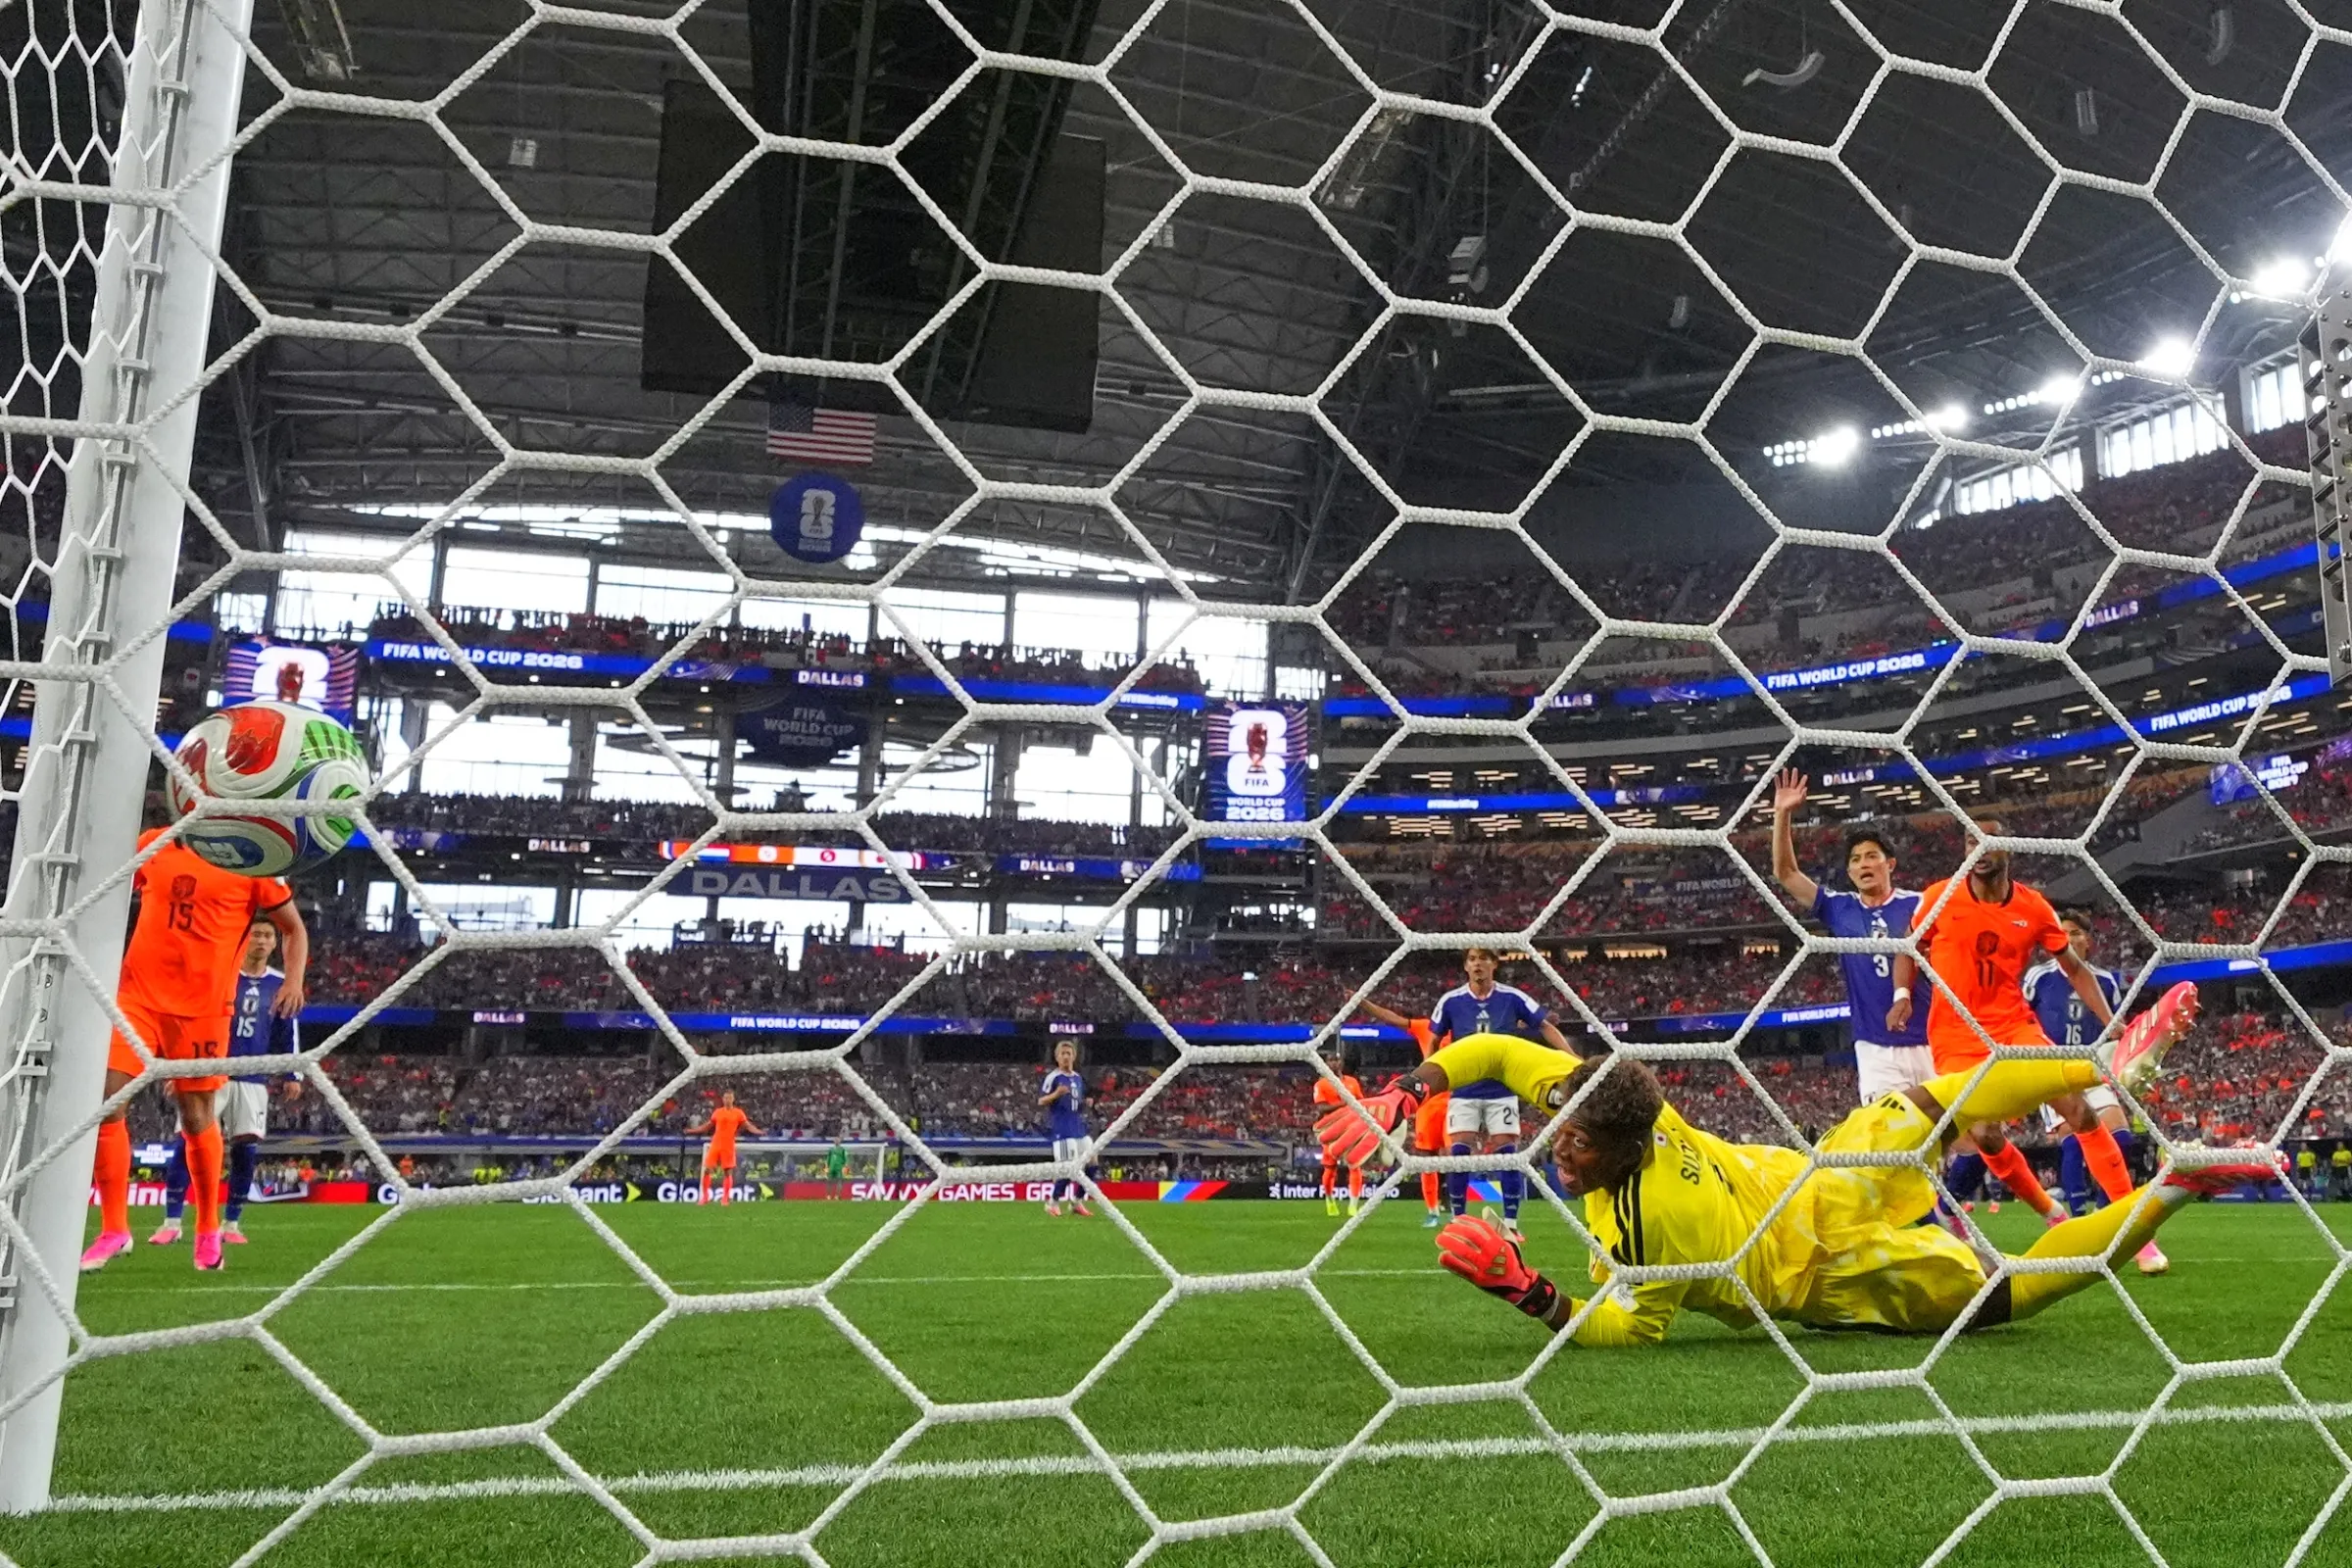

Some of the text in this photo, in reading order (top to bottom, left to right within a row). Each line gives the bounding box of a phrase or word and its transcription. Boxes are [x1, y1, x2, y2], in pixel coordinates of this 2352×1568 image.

[2085, 601, 2138, 627] DALLAS
[382, 643, 583, 669] FIFA WOLD CUP 2026
[798, 670, 864, 686] DALLAS
[1767, 654, 1926, 689] FIFA WORLD CUP 2026
[1534, 694, 1592, 708] DLLAS
[793, 707, 825, 722] FIFA
[2151, 713, 2178, 731] FIFA
[2177, 703, 2222, 726] WORLD
[2222, 697, 2246, 713] CUP
[763, 717, 855, 736] WORLD CUP
[1245, 778, 1269, 787] FIFA
[1823, 769, 1874, 787] DALLAS
[1227, 797, 1286, 808] WORLD CUP
[1226, 807, 1285, 821] 2026
[527, 839, 590, 853] DALLAS
[1020, 859, 1075, 873] DALLAS
[692, 870, 902, 902] DALLAS
[1676, 877, 1741, 892] FIFA WORLD
[169, 903, 193, 930] 15
[1873, 954, 1889, 977] 3
[1977, 958, 1994, 988] 11
[473, 1011, 524, 1023] DALLAS
[731, 1017, 755, 1028] FIFA
[756, 1017, 797, 1029] WORLD
[798, 1018, 820, 1029] CUP
[236, 1016, 257, 1037] 15
[1050, 1023, 1094, 1034] DALLAS
[2066, 1024, 2082, 1046] 16
[1503, 1107, 1518, 1125] 2
[852, 1183, 927, 1200] SAVVY
[938, 1183, 1015, 1200] GAMES
[1284, 1185, 1317, 1198] Inter
